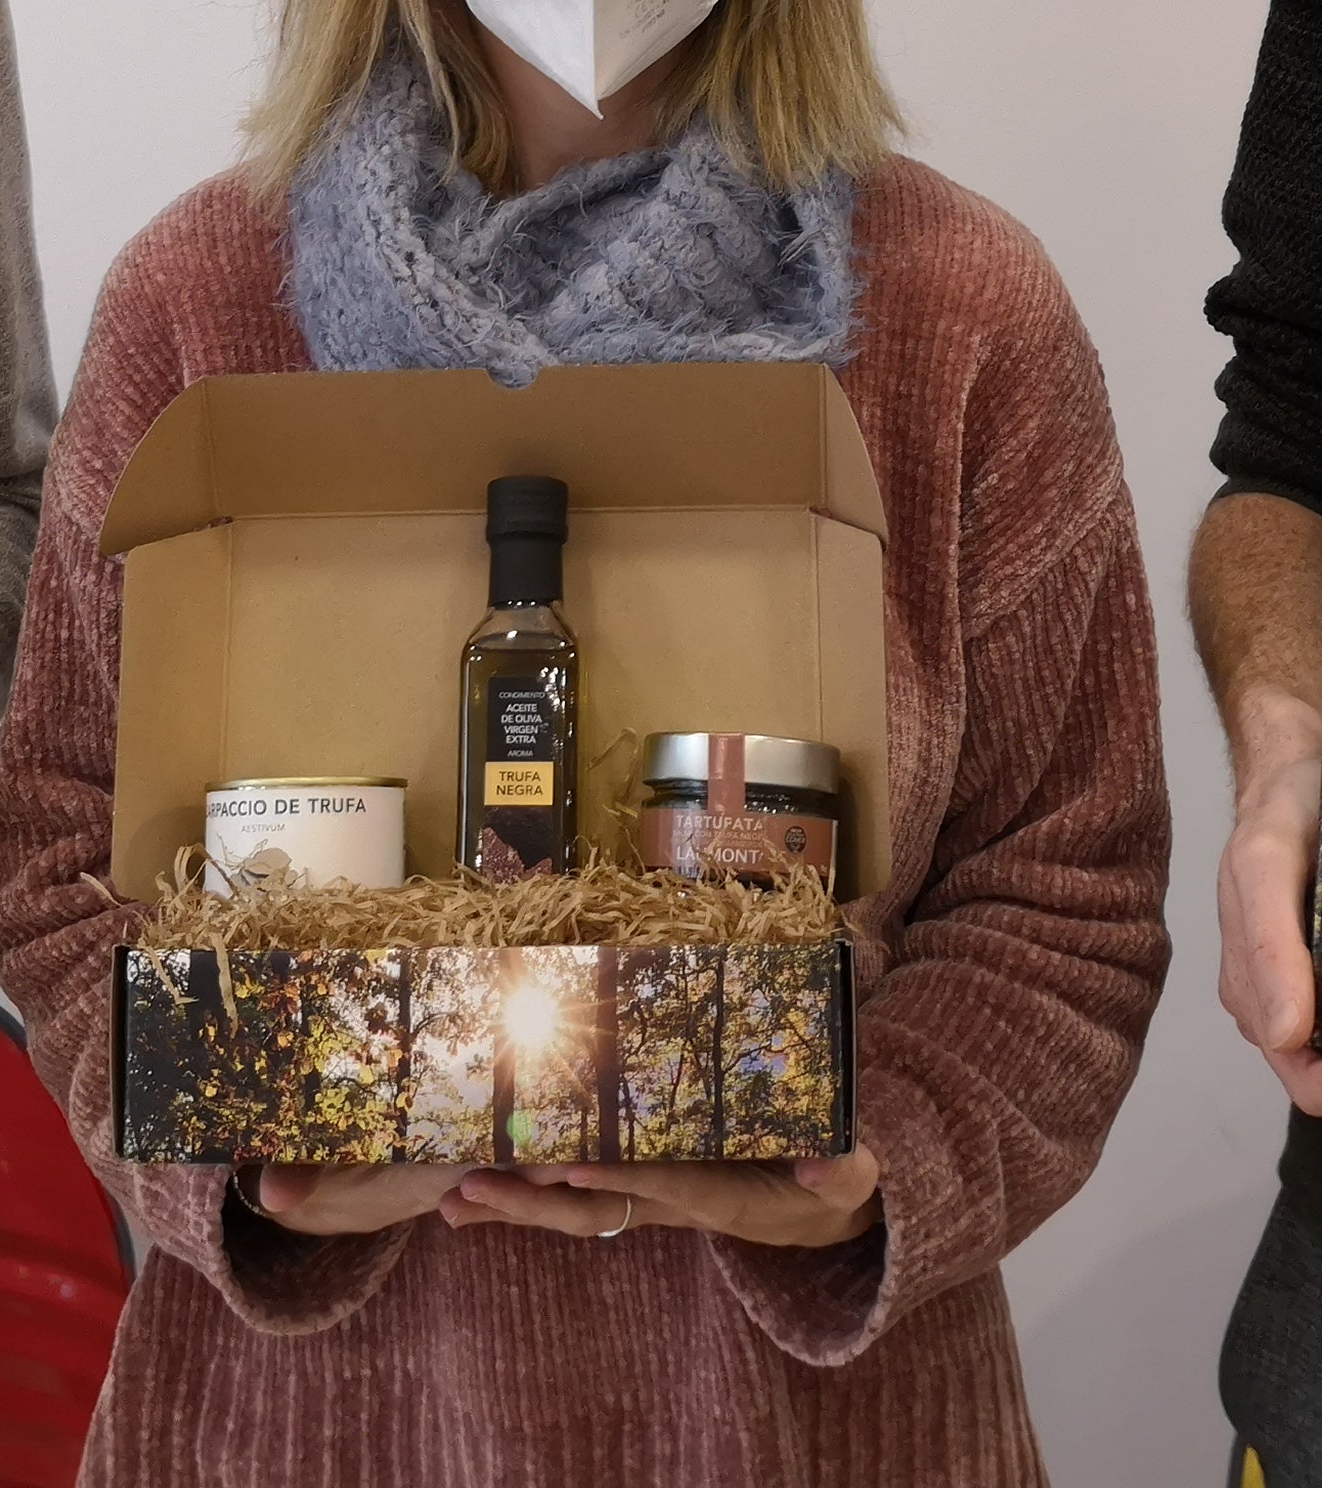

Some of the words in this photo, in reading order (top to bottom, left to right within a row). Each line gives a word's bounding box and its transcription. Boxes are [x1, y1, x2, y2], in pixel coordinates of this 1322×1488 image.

[506, 703, 538, 712] ACEITE
[501, 714, 513, 723] DE
[515, 714, 543, 723] OLIVA
[504, 725, 539, 734] VIRGEN
[505, 735, 537, 744] EXTRA
[498, 770, 542, 782] TRUFA
[495, 785, 544, 796] NEGRA
[275, 798, 301, 815] DE
[307, 798, 367, 814] TRUFA
[676, 815, 763, 831] TARTUFATA
